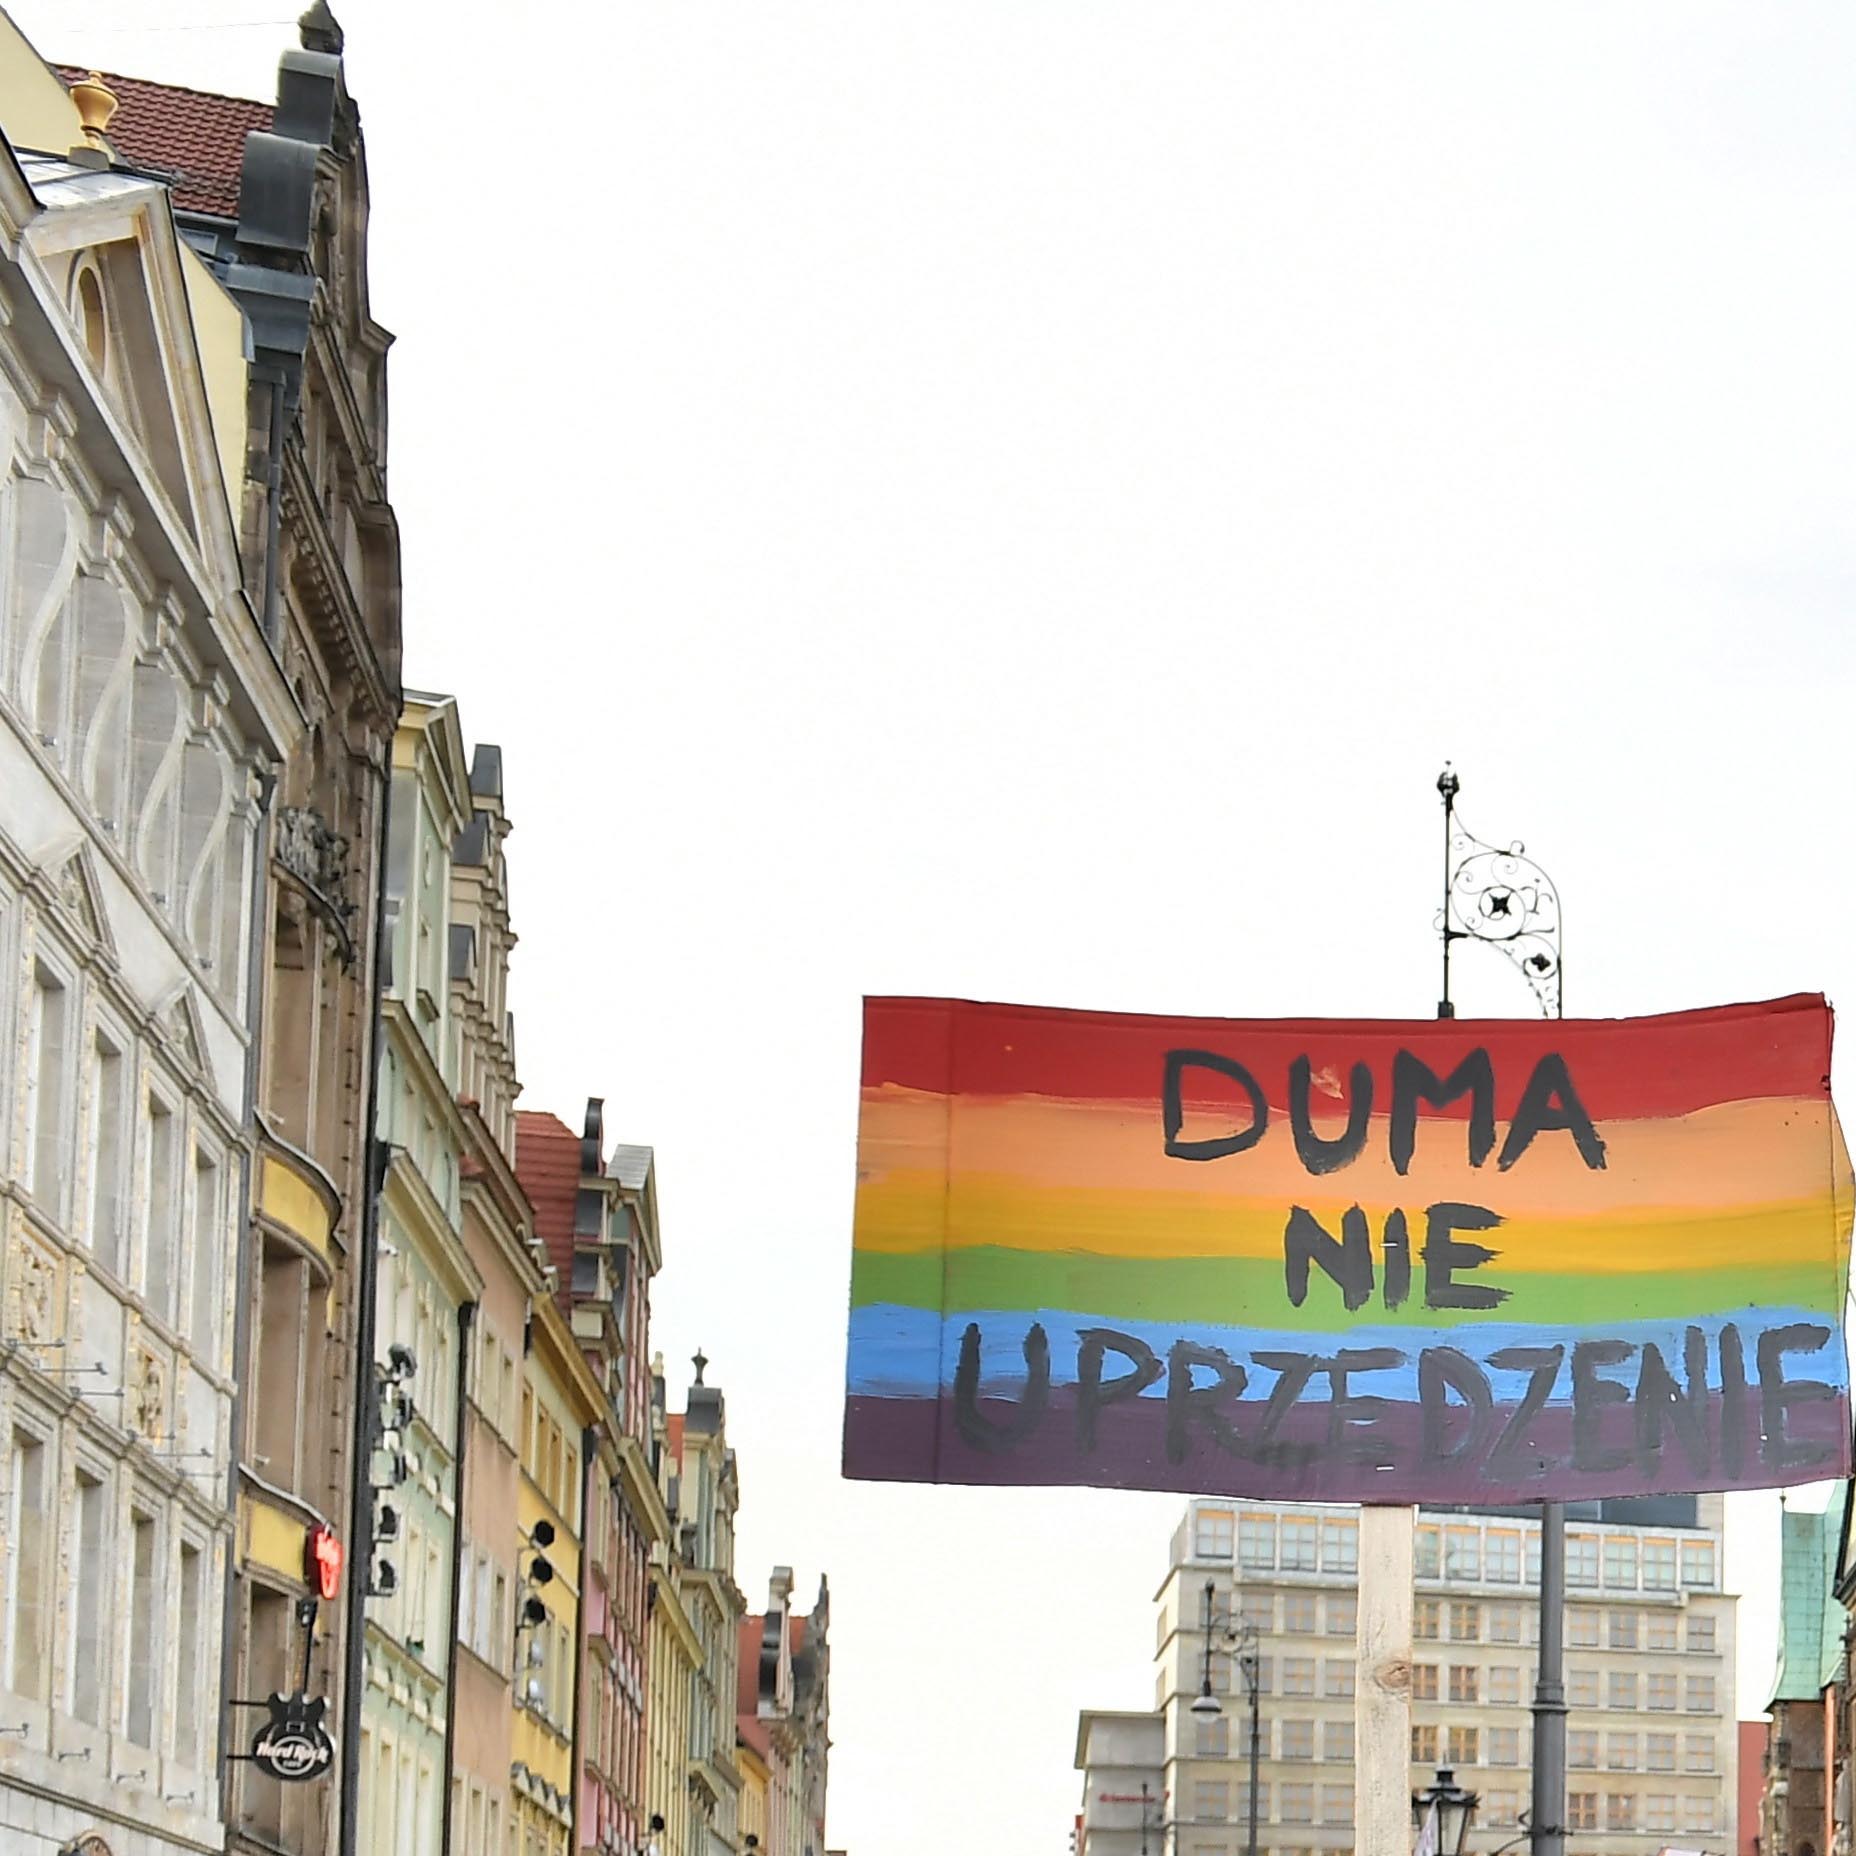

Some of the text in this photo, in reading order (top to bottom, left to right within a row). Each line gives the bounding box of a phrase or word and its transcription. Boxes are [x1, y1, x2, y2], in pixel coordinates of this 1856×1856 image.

[1161, 1046, 1607, 1176] DUMA
[1284, 1199, 1513, 1311] NIE
[953, 1321, 1840, 1483] UPRZEDZENIE
